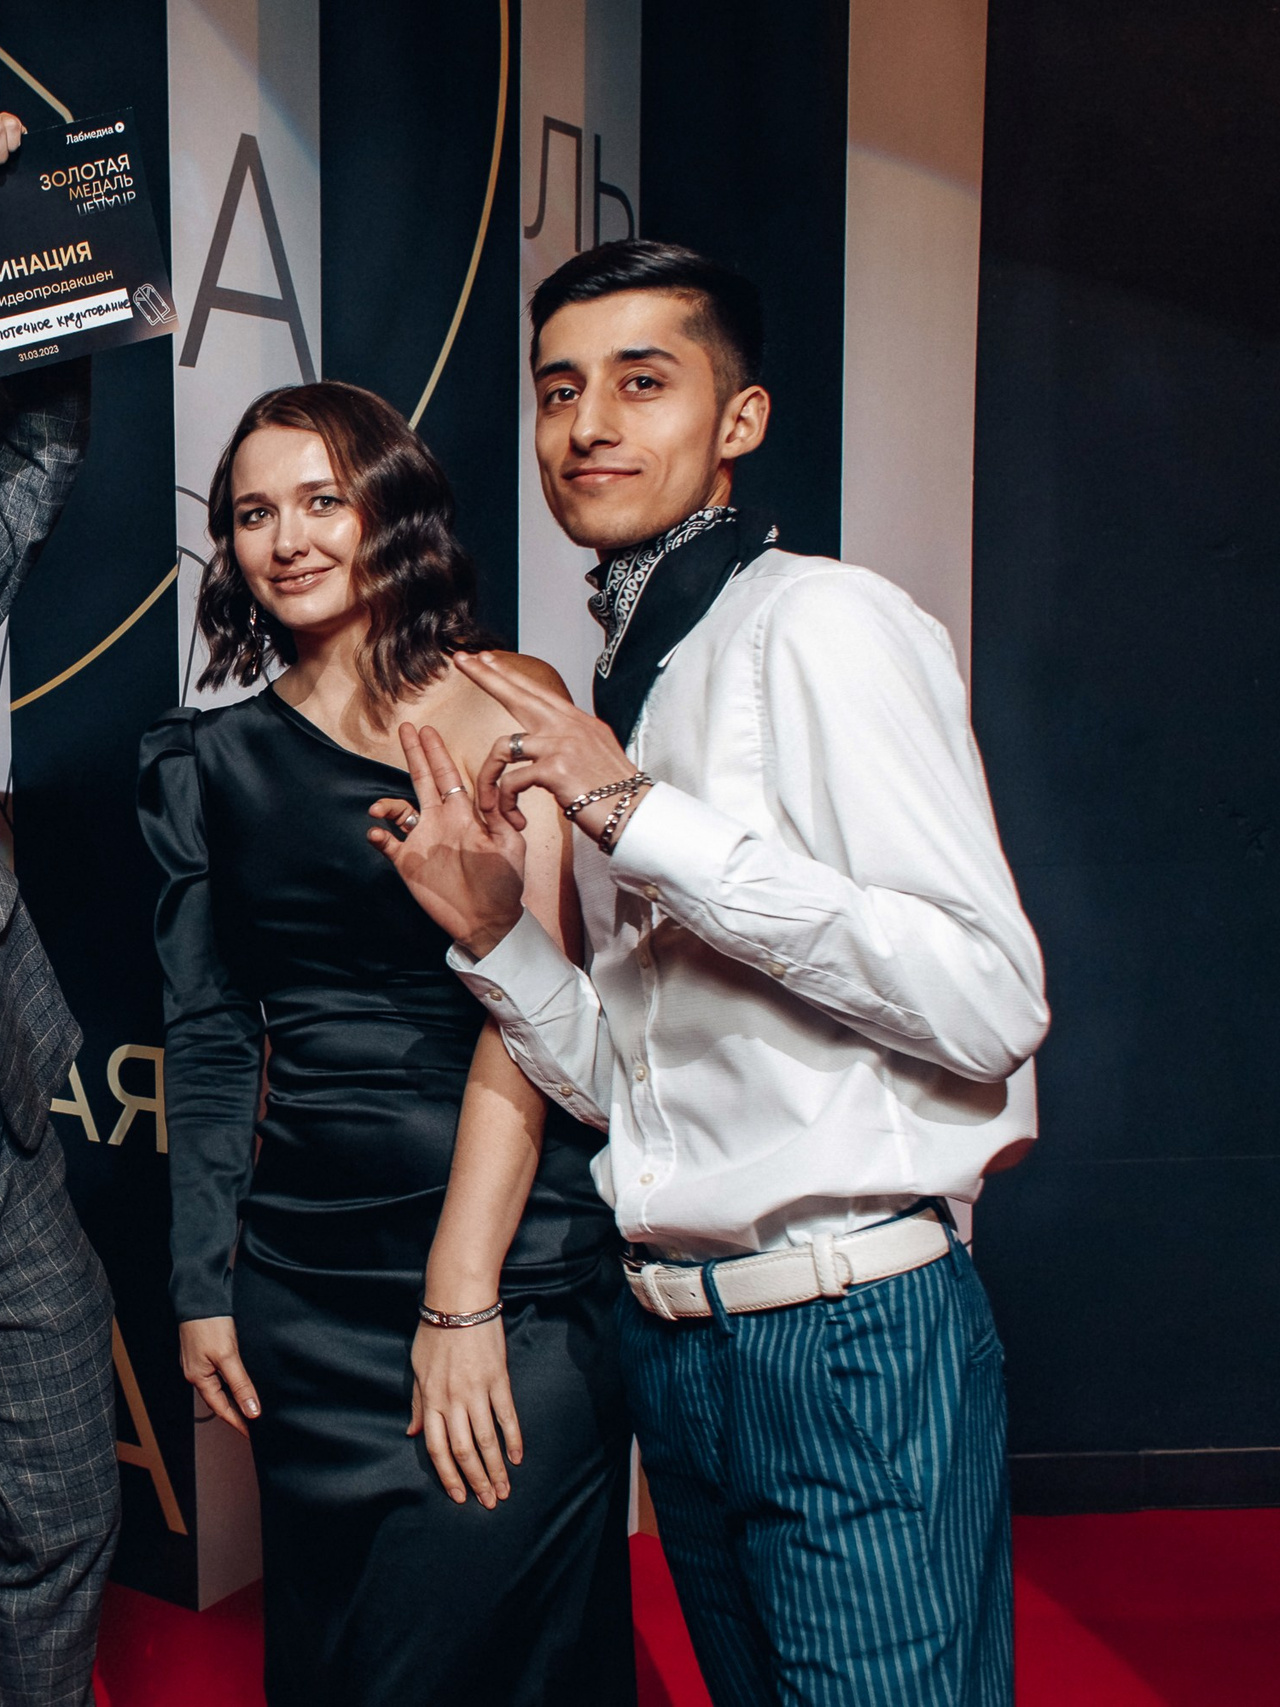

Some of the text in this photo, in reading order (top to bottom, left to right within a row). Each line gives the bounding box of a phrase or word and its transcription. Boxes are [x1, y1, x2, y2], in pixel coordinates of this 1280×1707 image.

[65, 126, 114, 145] Лабмедиа
[39, 153, 131, 191] ЗОЛОТАЯ
[68, 173, 134, 201] МЕДАЛЬ
[56, 298, 132, 329] кредитование
[18, 344, 60, 363] 31.03.2023
